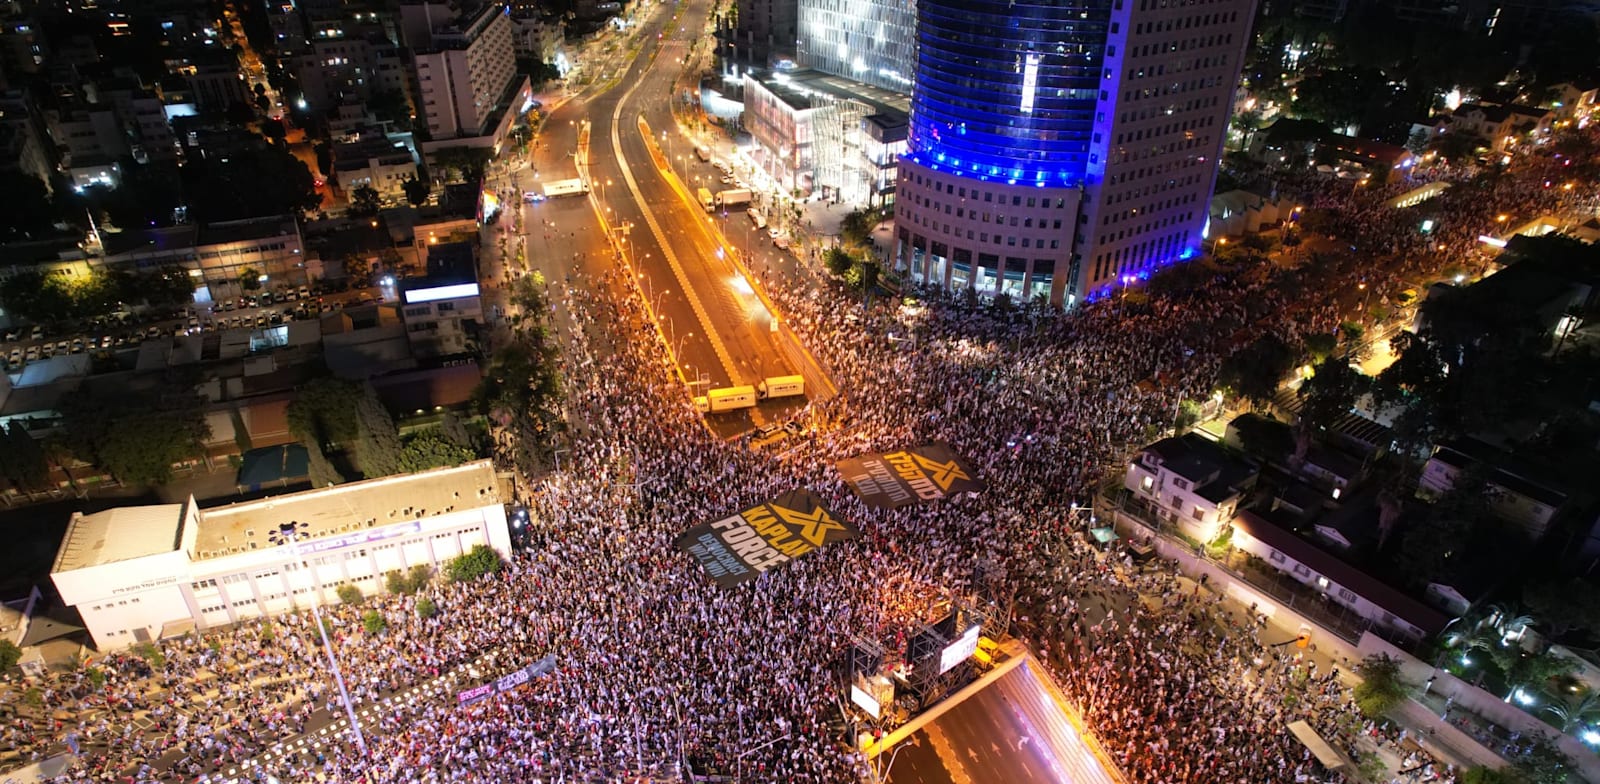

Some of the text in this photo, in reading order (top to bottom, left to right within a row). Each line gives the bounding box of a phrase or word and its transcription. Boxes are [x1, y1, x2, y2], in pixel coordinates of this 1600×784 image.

[851, 474, 881, 495] תנצח
[862, 460, 911, 502] הדמוקרטיה
[710, 514, 791, 573] FORCE
[741, 504, 814, 558] KAPLAN
[687, 543, 728, 577] WILL WIN
[697, 532, 749, 576] DEMOCRACY
